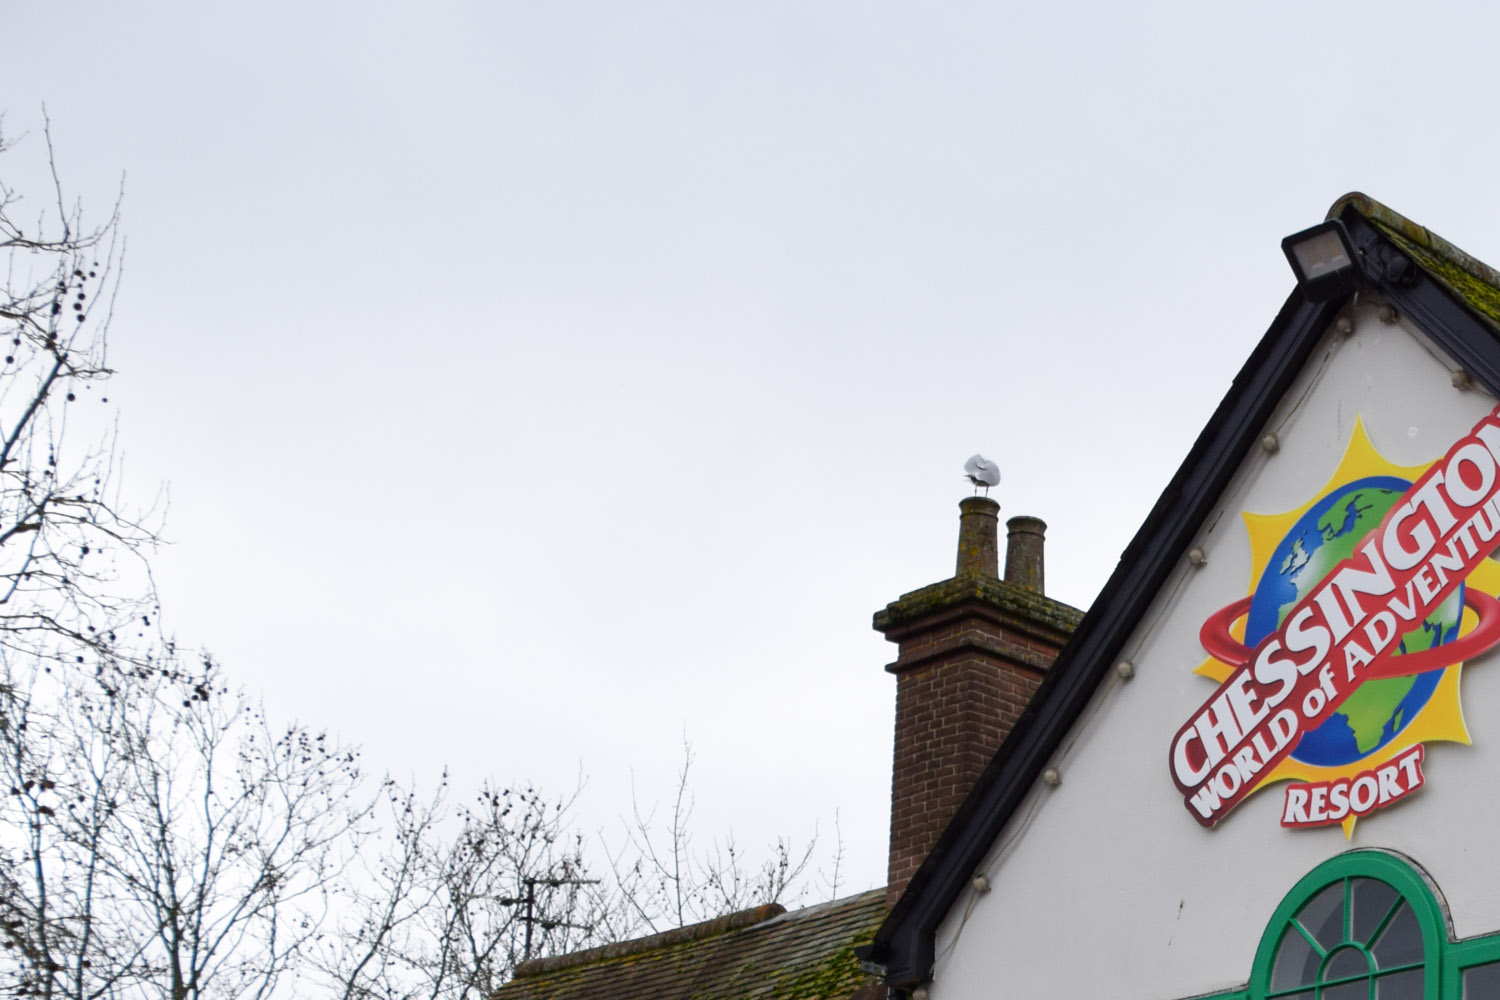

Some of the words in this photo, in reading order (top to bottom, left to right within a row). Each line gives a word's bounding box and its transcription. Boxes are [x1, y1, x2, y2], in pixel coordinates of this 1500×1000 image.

[1190, 708, 1298, 820] WORLD
[1302, 664, 1335, 719] of
[1283, 752, 1423, 823] RESORT
